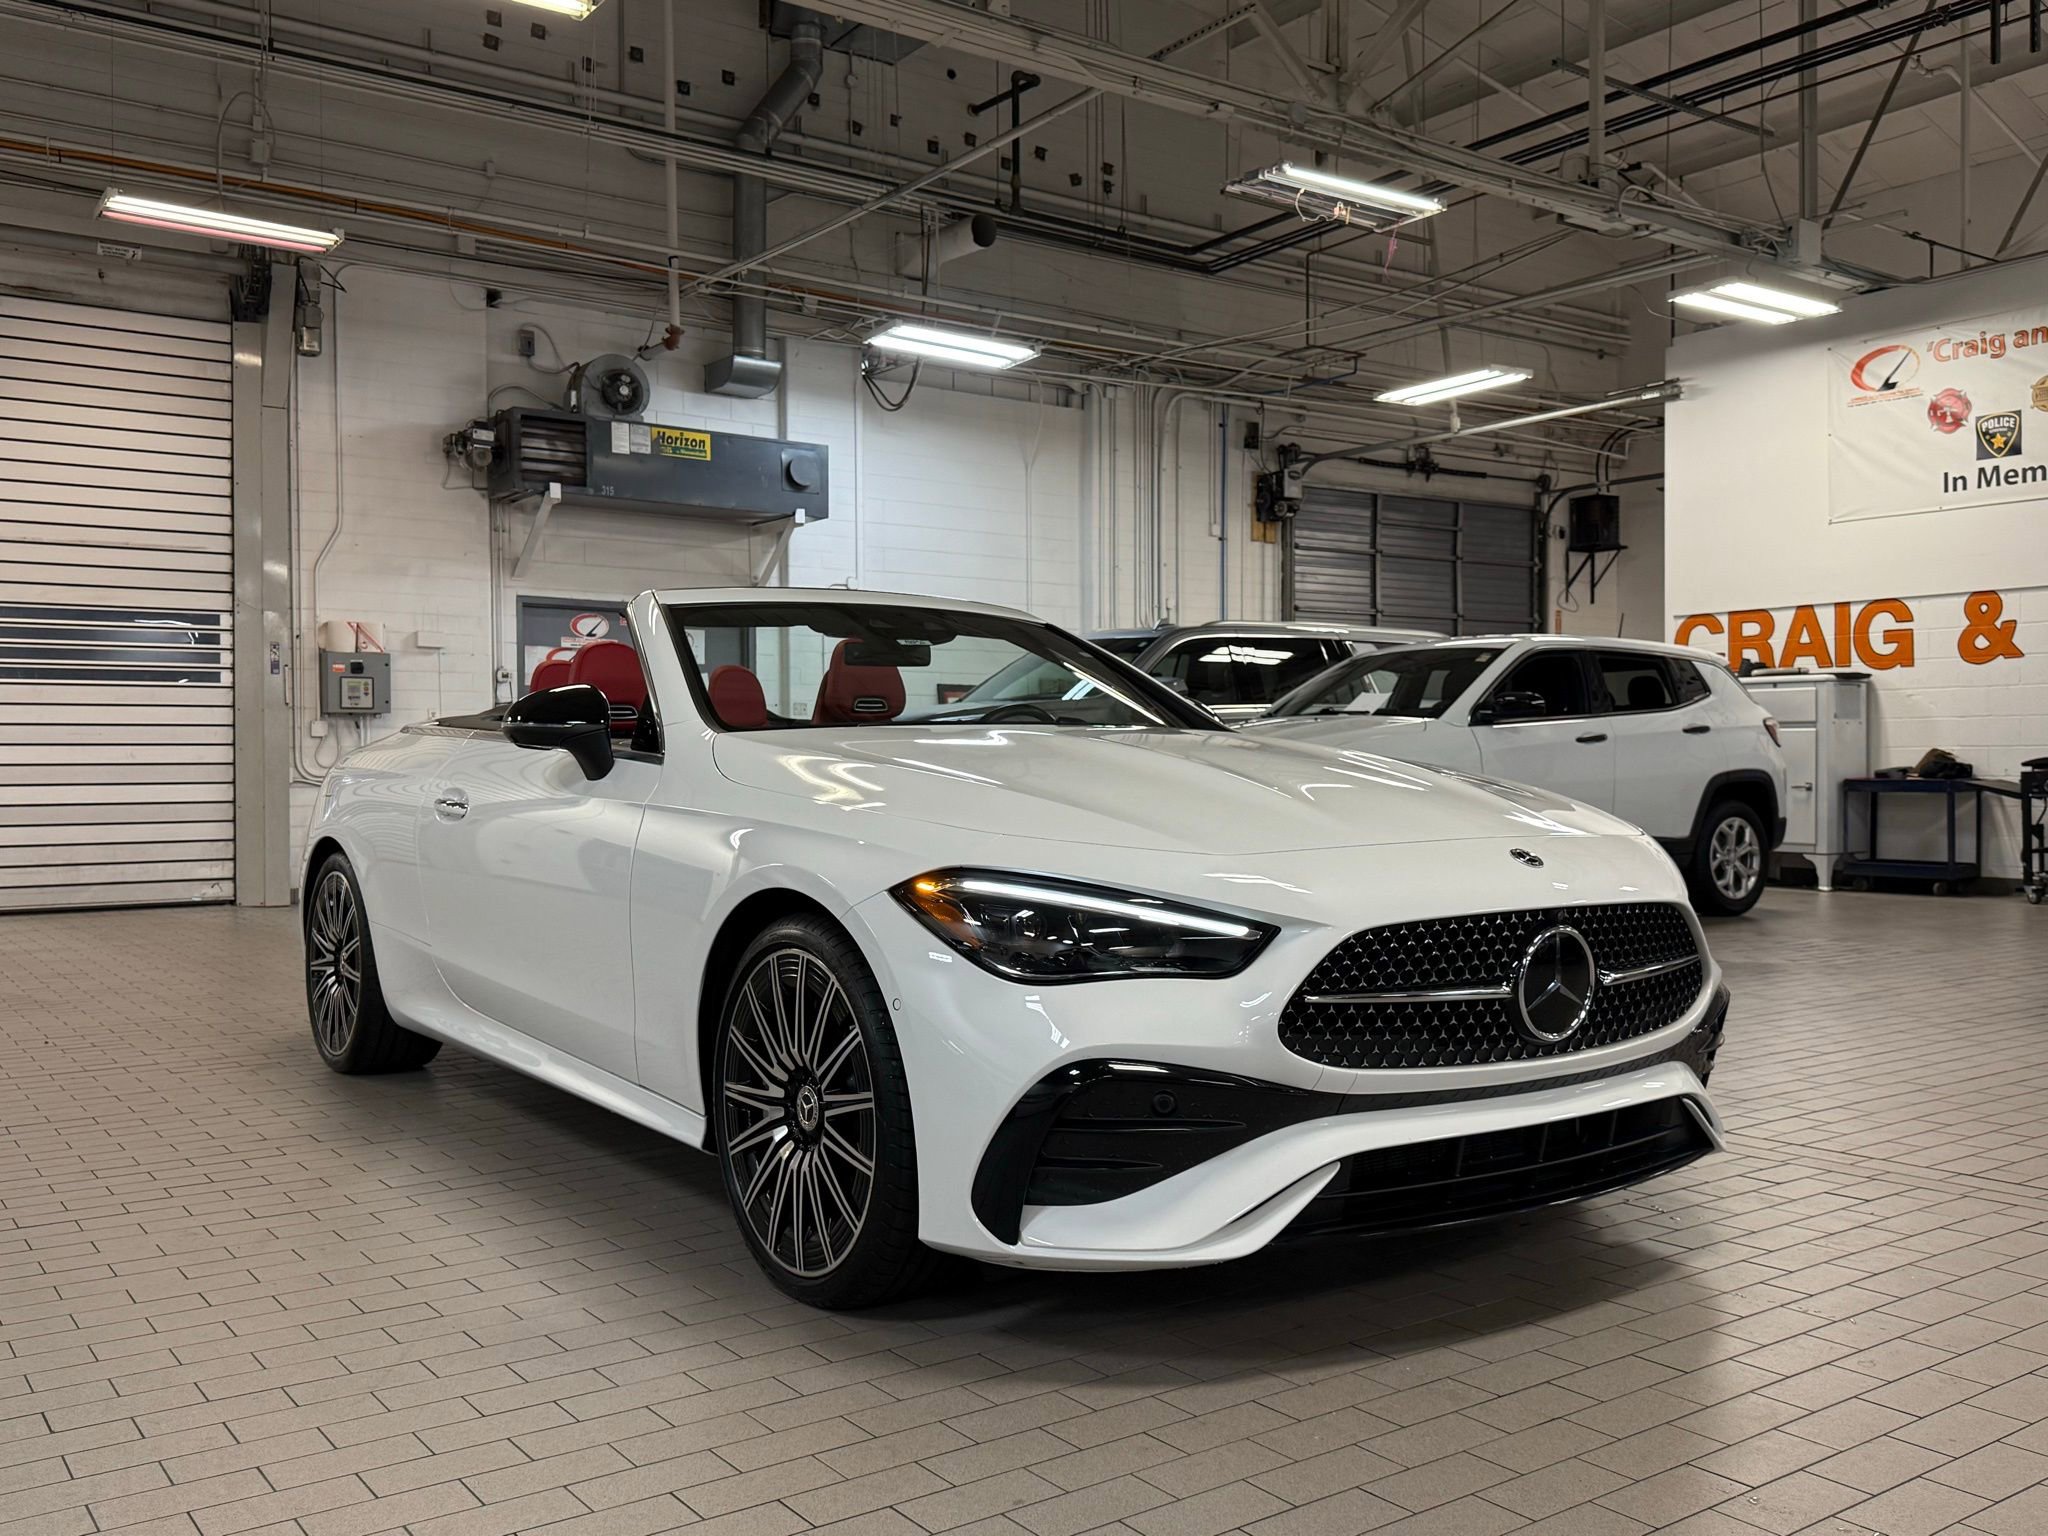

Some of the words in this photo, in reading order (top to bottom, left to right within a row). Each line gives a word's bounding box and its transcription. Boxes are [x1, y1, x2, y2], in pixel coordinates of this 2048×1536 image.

[1981, 416, 2016, 432] POLICE
[1943, 471, 1967, 493] In
[1976, 464, 2048, 489] Mem
[1957, 590, 2025, 665] &
